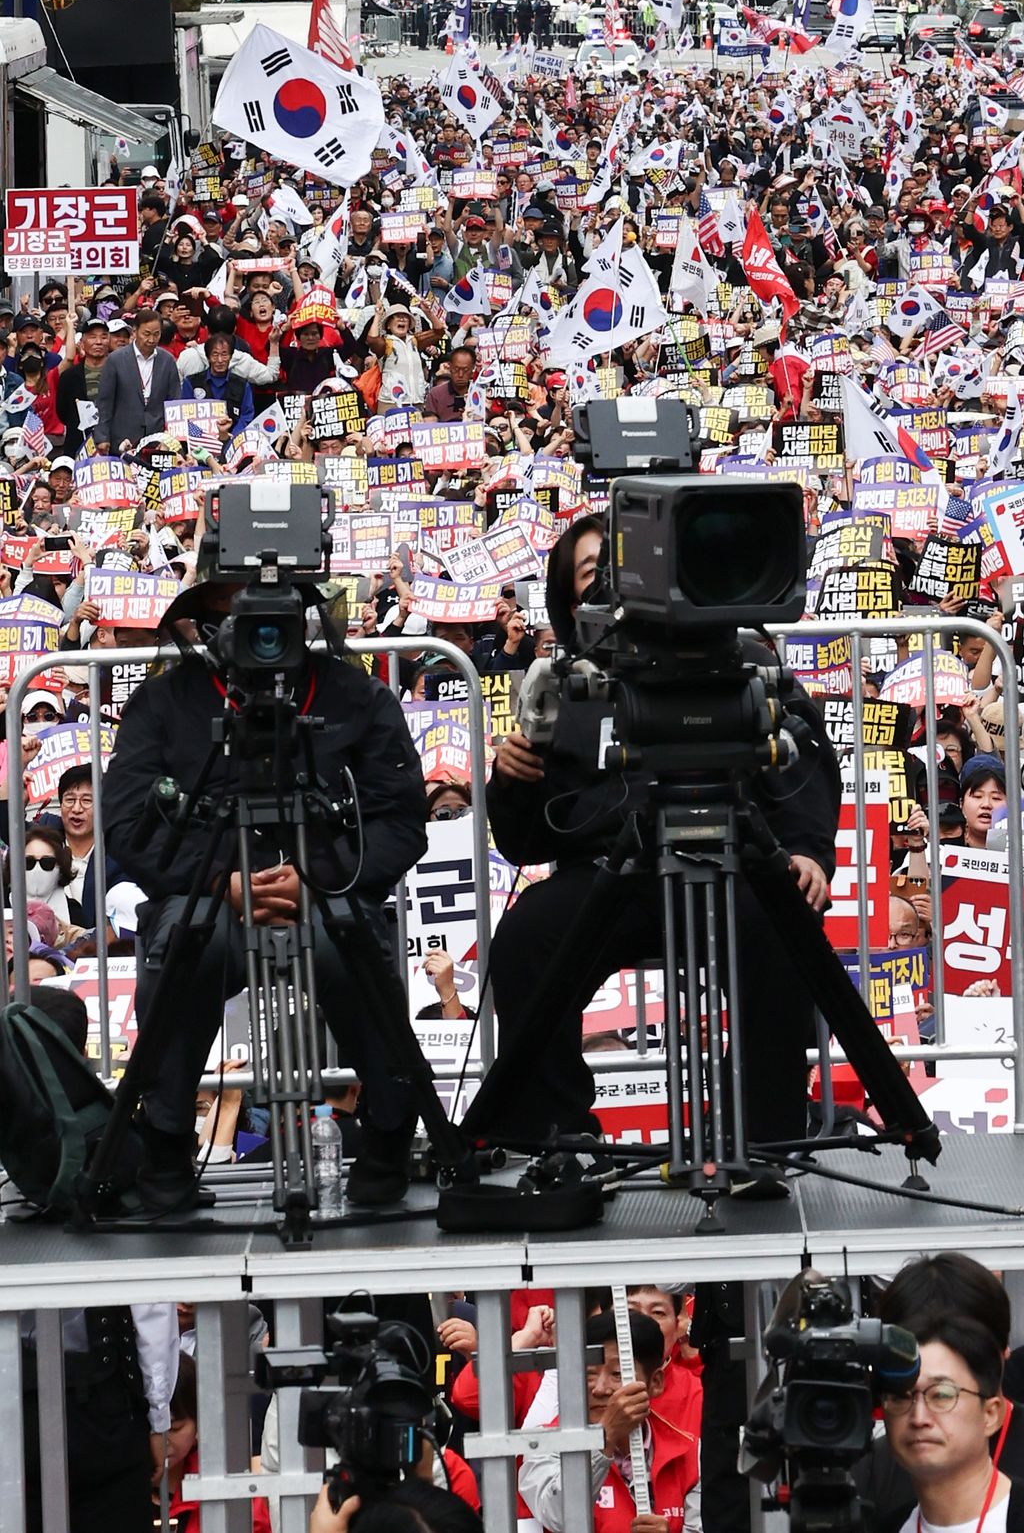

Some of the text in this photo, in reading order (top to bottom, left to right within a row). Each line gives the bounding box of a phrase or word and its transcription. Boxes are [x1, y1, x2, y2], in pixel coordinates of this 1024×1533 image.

[7, 233, 67, 254] 기장군
[7, 256, 67, 269] 당원협의회
[782, 425, 839, 444] 민생파탄
[252, 521, 289, 529] Panasonic
[824, 571, 893, 594] 민생파탄
[819, 590, 893, 613] 사법파괴
[962, 857, 1000, 872] 국민의힘
